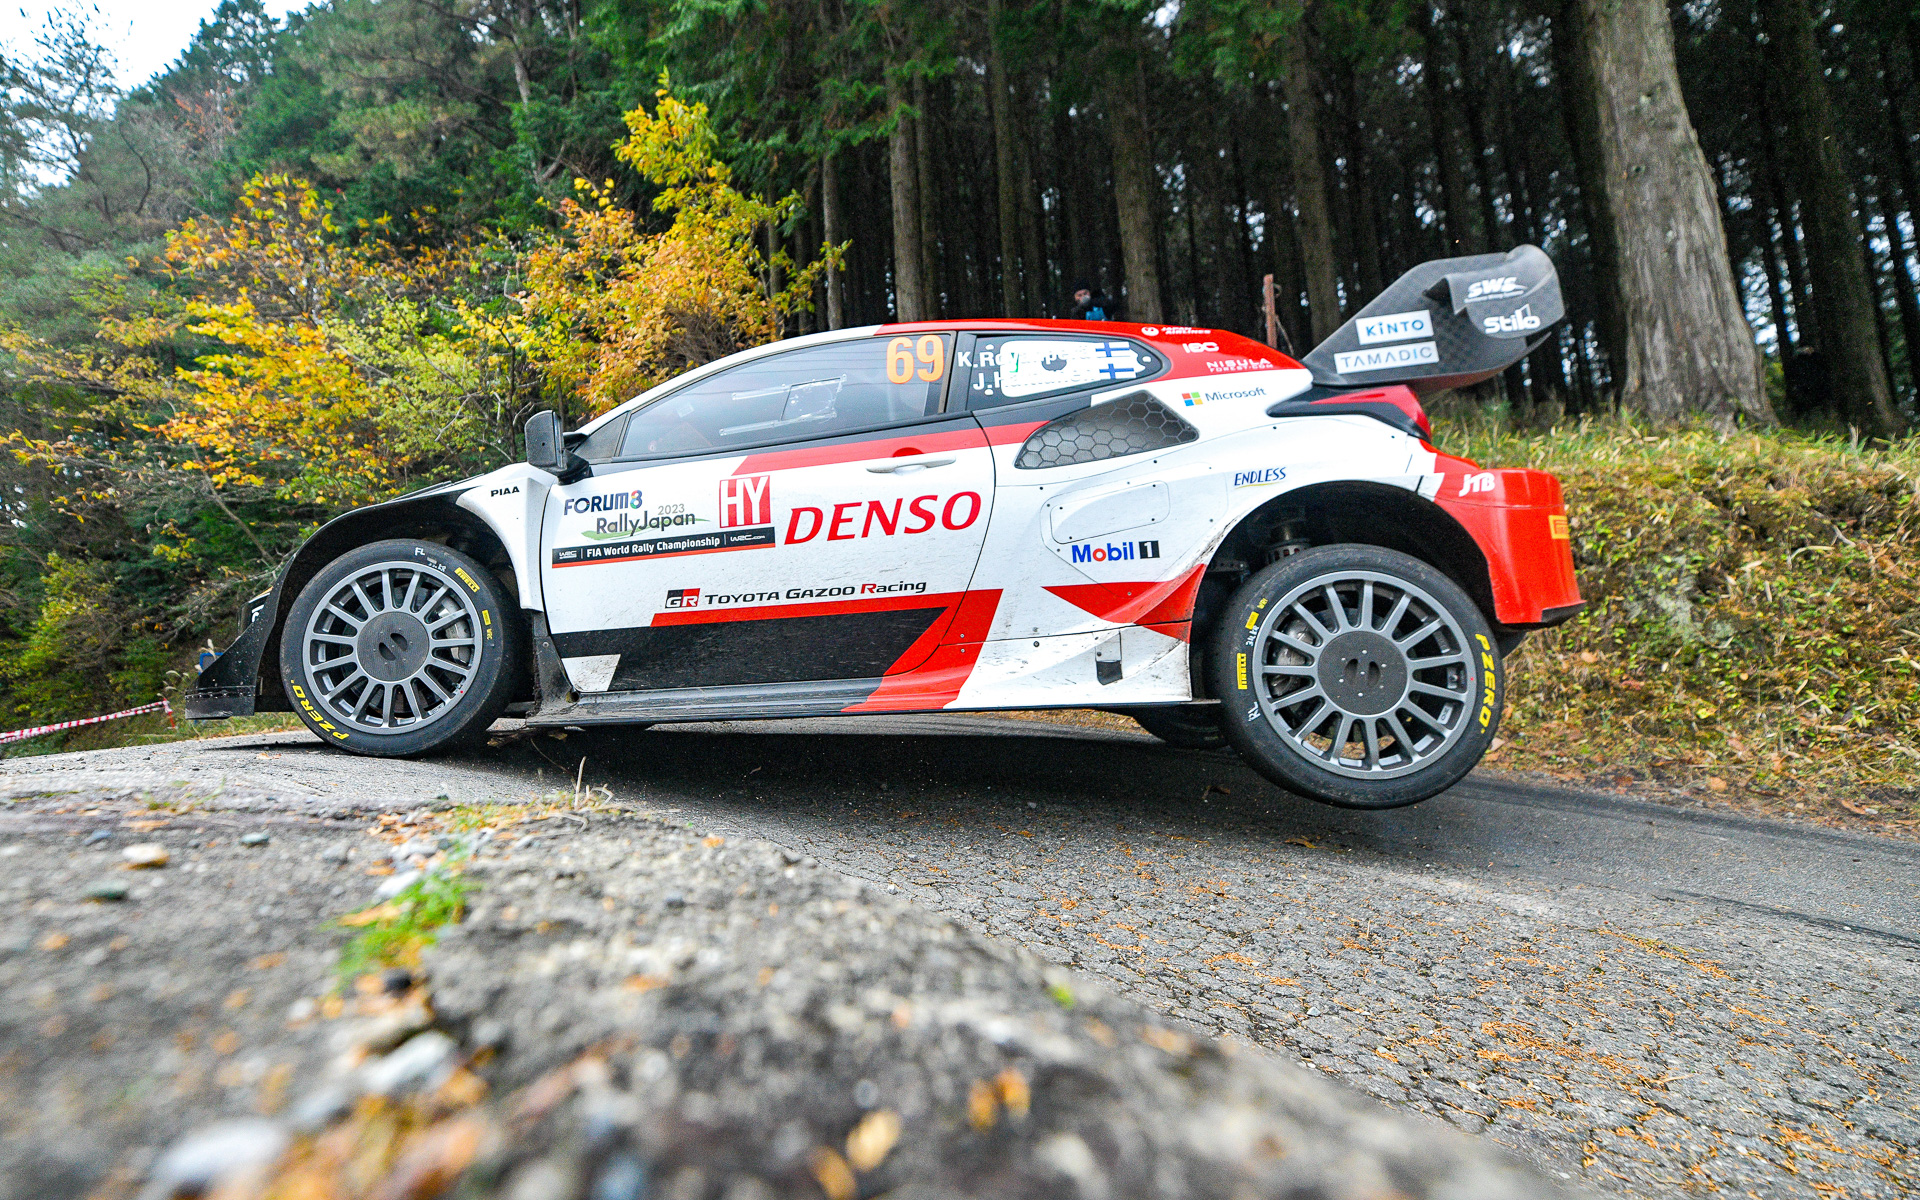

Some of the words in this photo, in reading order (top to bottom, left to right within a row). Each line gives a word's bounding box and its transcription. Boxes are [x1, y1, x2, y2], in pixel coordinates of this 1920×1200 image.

[1483, 303, 1541, 335] Stilo
[886, 334, 945, 385] 69
[1340, 346, 1433, 369] TAMADIC
[1205, 387, 1268, 402] Microsoft
[1234, 467, 1287, 485] ENDLESS
[1458, 472, 1496, 497] JTB
[490, 486, 521, 498] PIAA
[720, 475, 770, 528] HY
[657, 503, 685, 516] 2023
[784, 491, 982, 546] DENSO
[587, 548, 602, 558] FIA
[603, 545, 629, 556] World
[632, 543, 655, 555] Rally
[656, 536, 720, 552] Championship
[1071, 541, 1134, 564] Mobil
[665, 588, 700, 608] GR
[704, 591, 780, 605] TOYOTA
[785, 586, 856, 600] GAZOO
[860, 580, 927, 595] Racing
